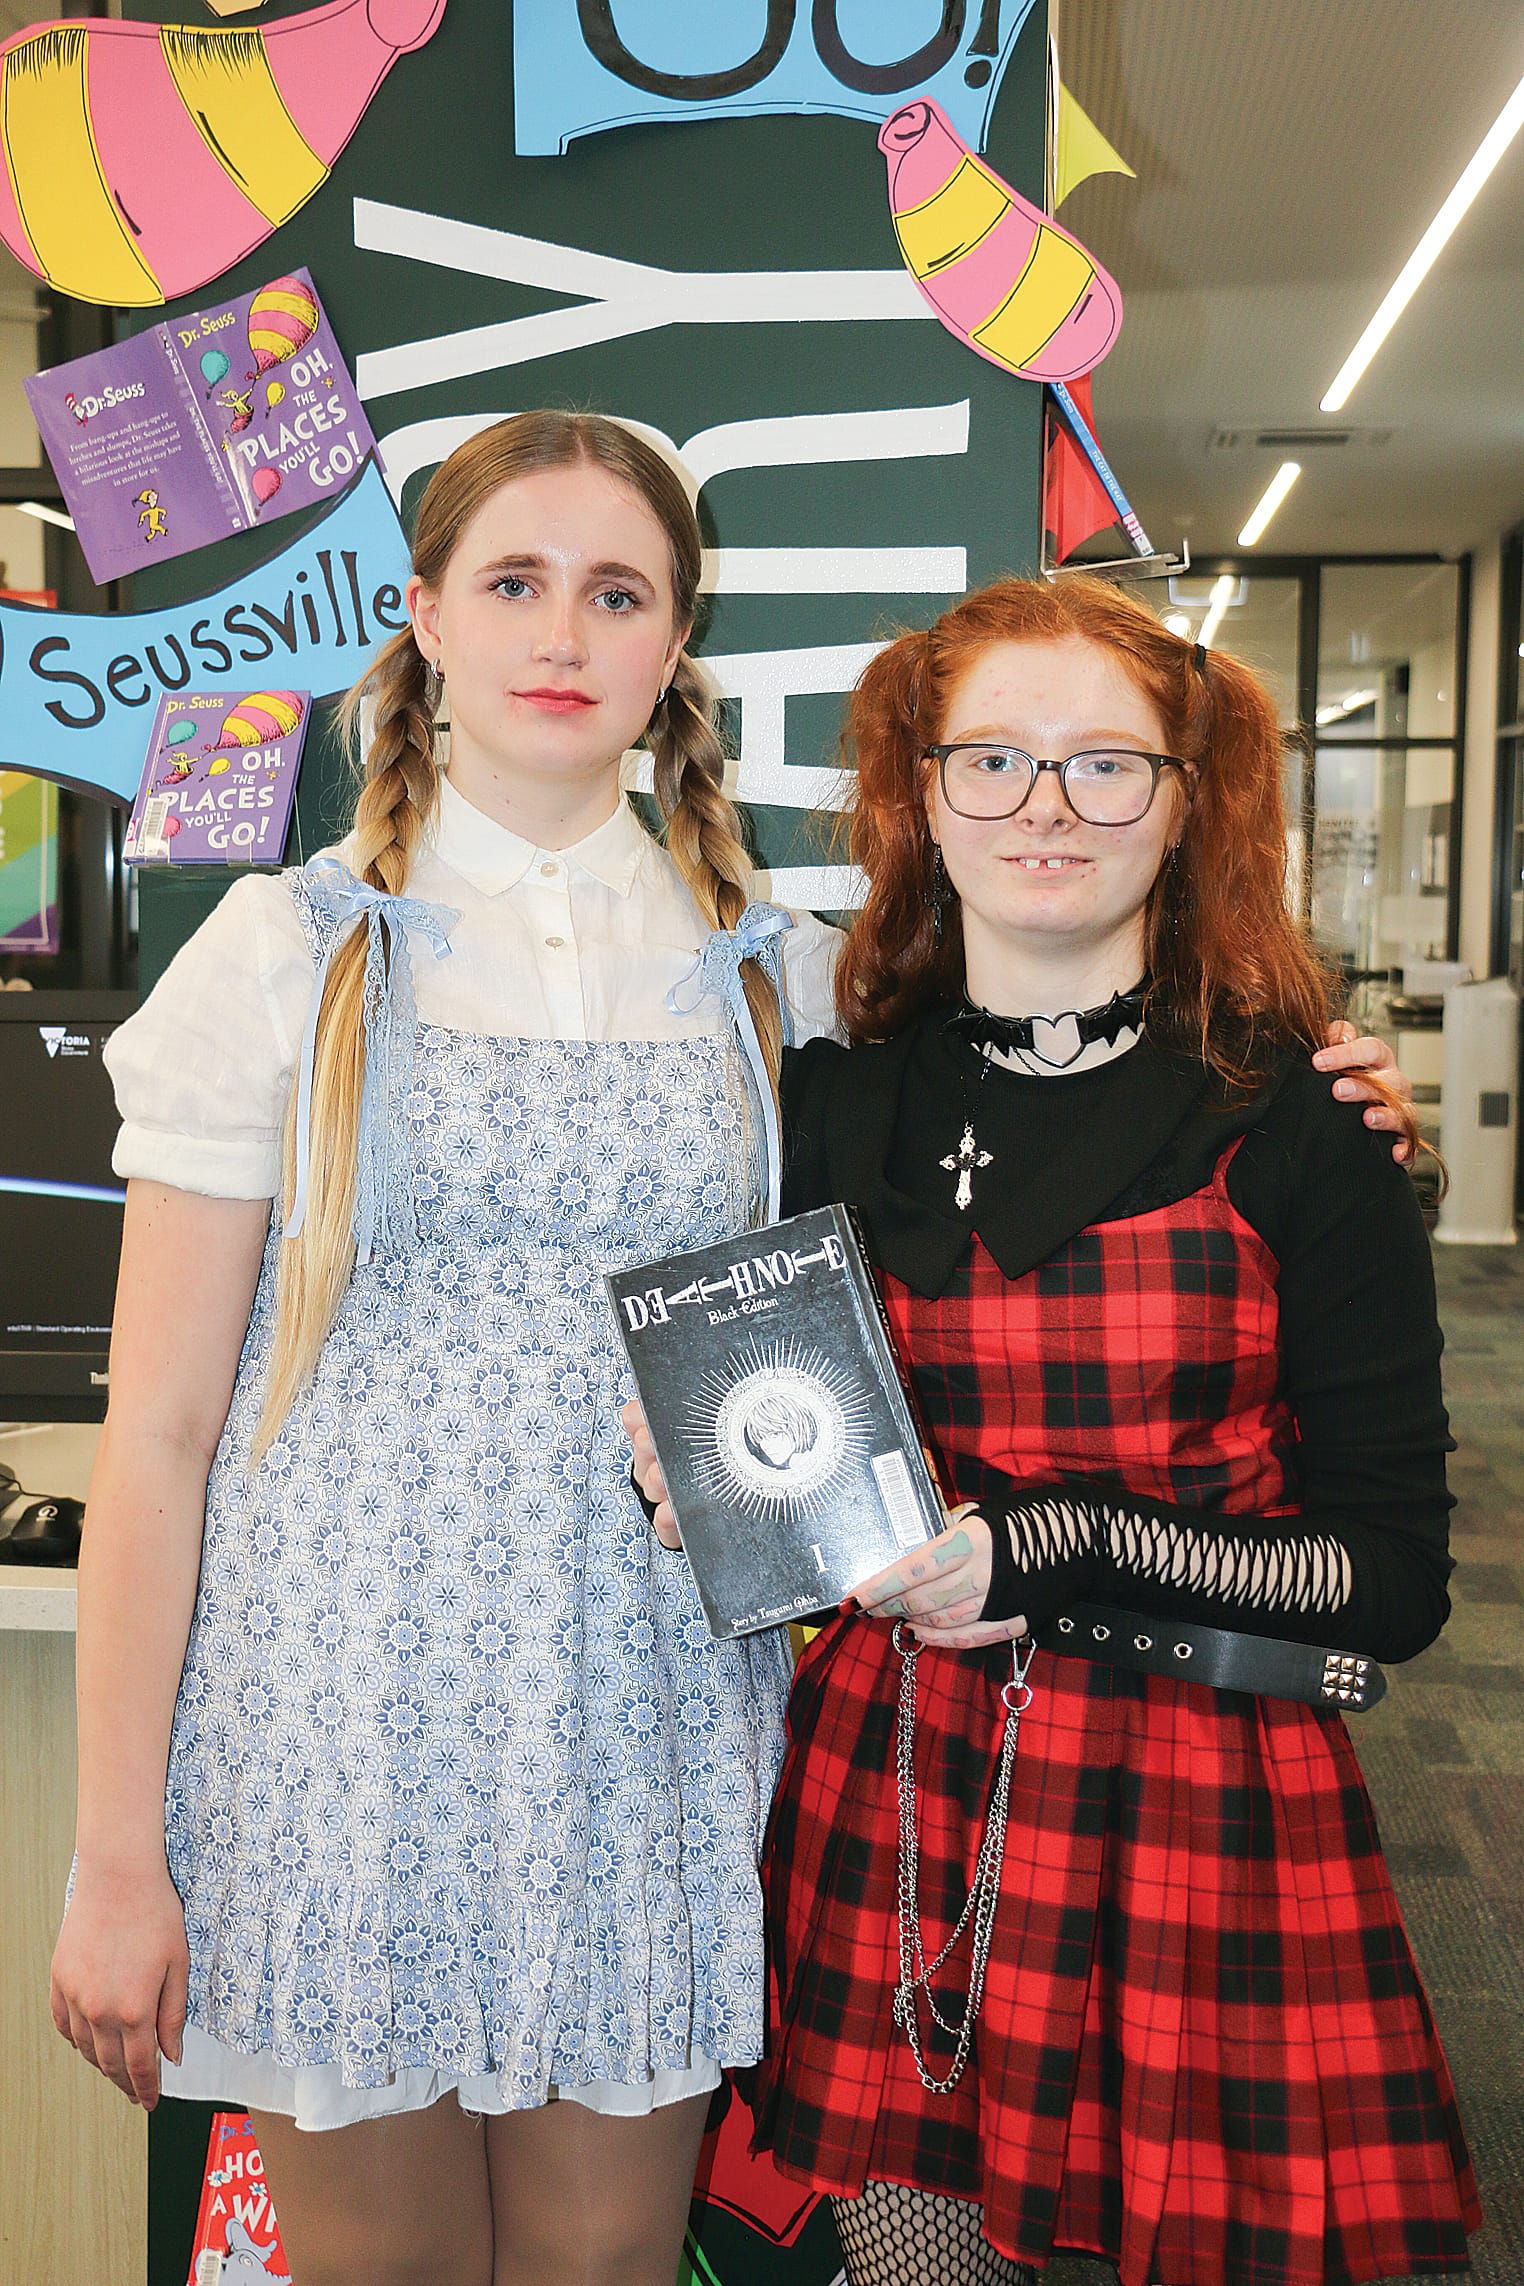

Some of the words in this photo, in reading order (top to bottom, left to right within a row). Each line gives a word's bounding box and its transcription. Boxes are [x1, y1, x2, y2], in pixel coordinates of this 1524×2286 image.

[178, 327, 201, 348] Dr.
[200, 311, 237, 336] Seuss
[293, 389, 318, 408] THE
[237, 395, 347, 467] PLACES
[279, 441, 321, 475] YOU'LL
[308, 431, 364, 487] GO!
[29, 550, 410, 729] Seussville
[166, 701, 186, 714] Dr.
[188, 696, 224, 710] Seuss
[232, 774, 256, 785] THE
[159, 785, 276, 812] PLACES
[185, 810, 232, 828] YOU'LL
[208, 816, 270, 849] GO!
[707, 1307, 740, 1325] Black
[739, 1297, 779, 1315] Edition
[757, 1603, 793, 1619] Tsugumi
[219, 2125, 238, 2141] Dr.
[210, 2194, 227, 2216] A
